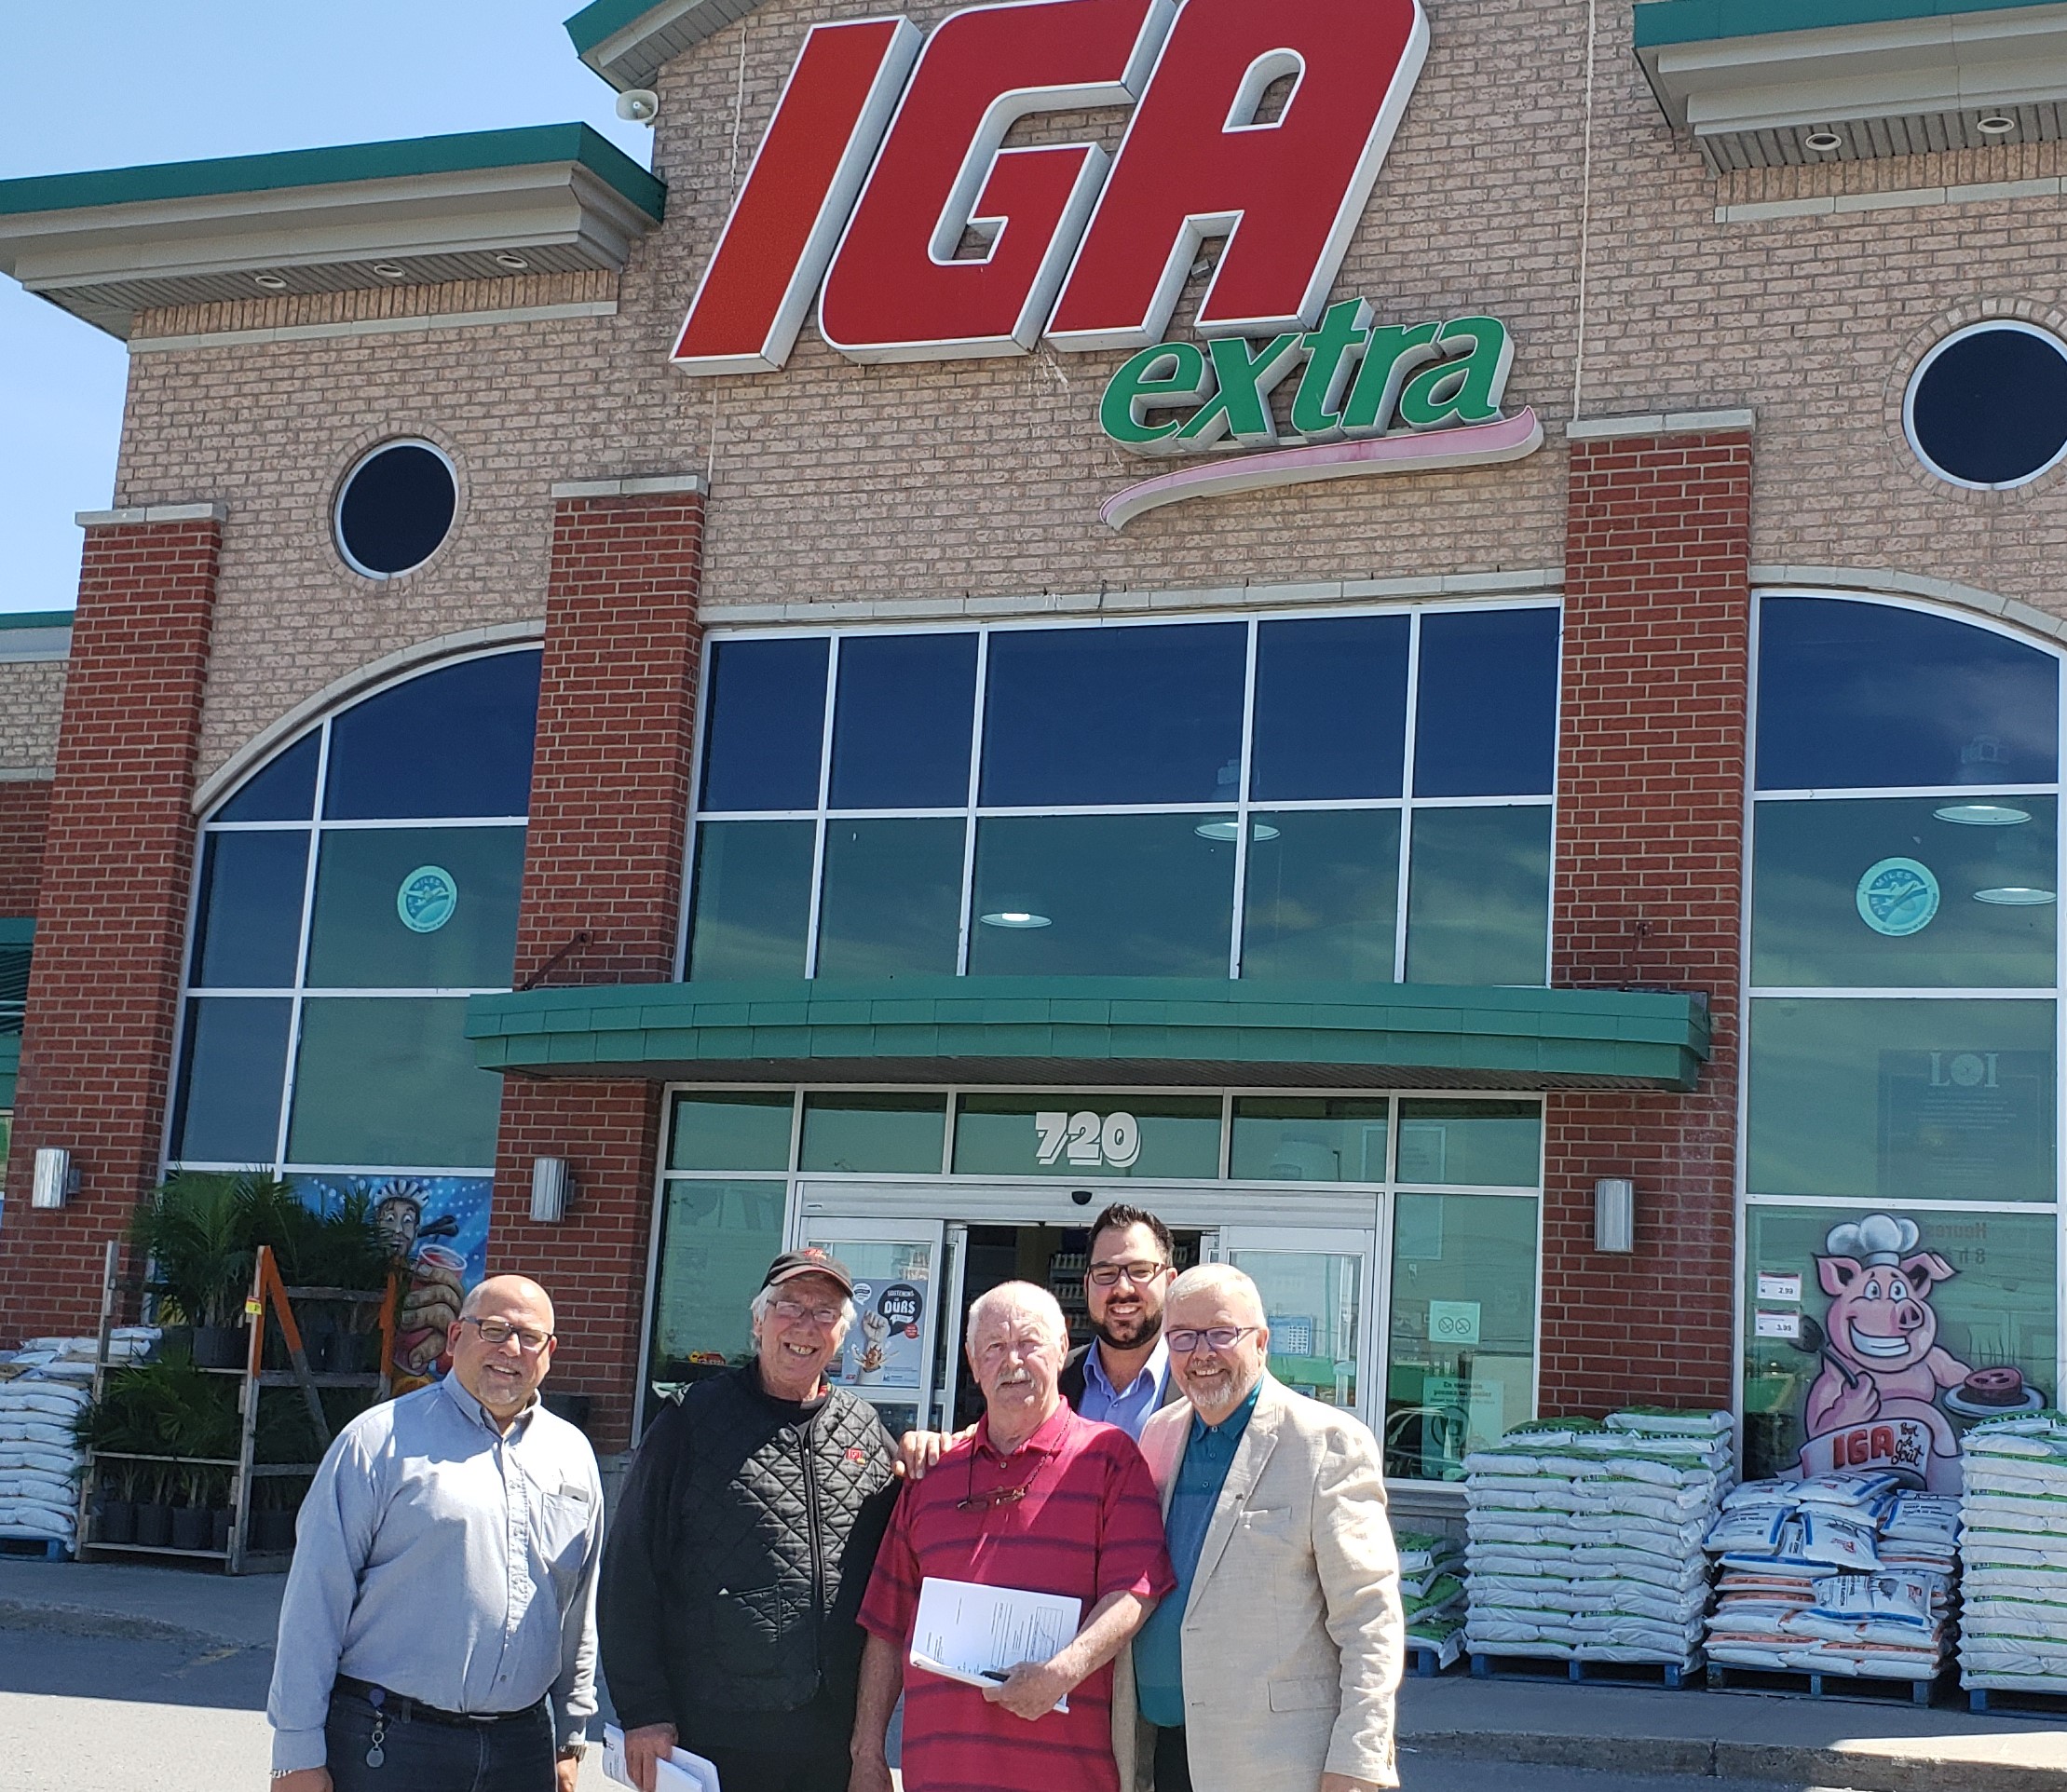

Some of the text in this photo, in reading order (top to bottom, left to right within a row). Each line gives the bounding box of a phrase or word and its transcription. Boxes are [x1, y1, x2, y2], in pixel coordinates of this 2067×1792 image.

[669, 0, 1430, 374] IGA
[1099, 296, 1515, 457] extra
[1875, 871, 1912, 888] MILES
[1035, 1110, 1141, 1168] 720
[884, 1299, 916, 1314] DURS
[1833, 1425, 1895, 1469] IGA
